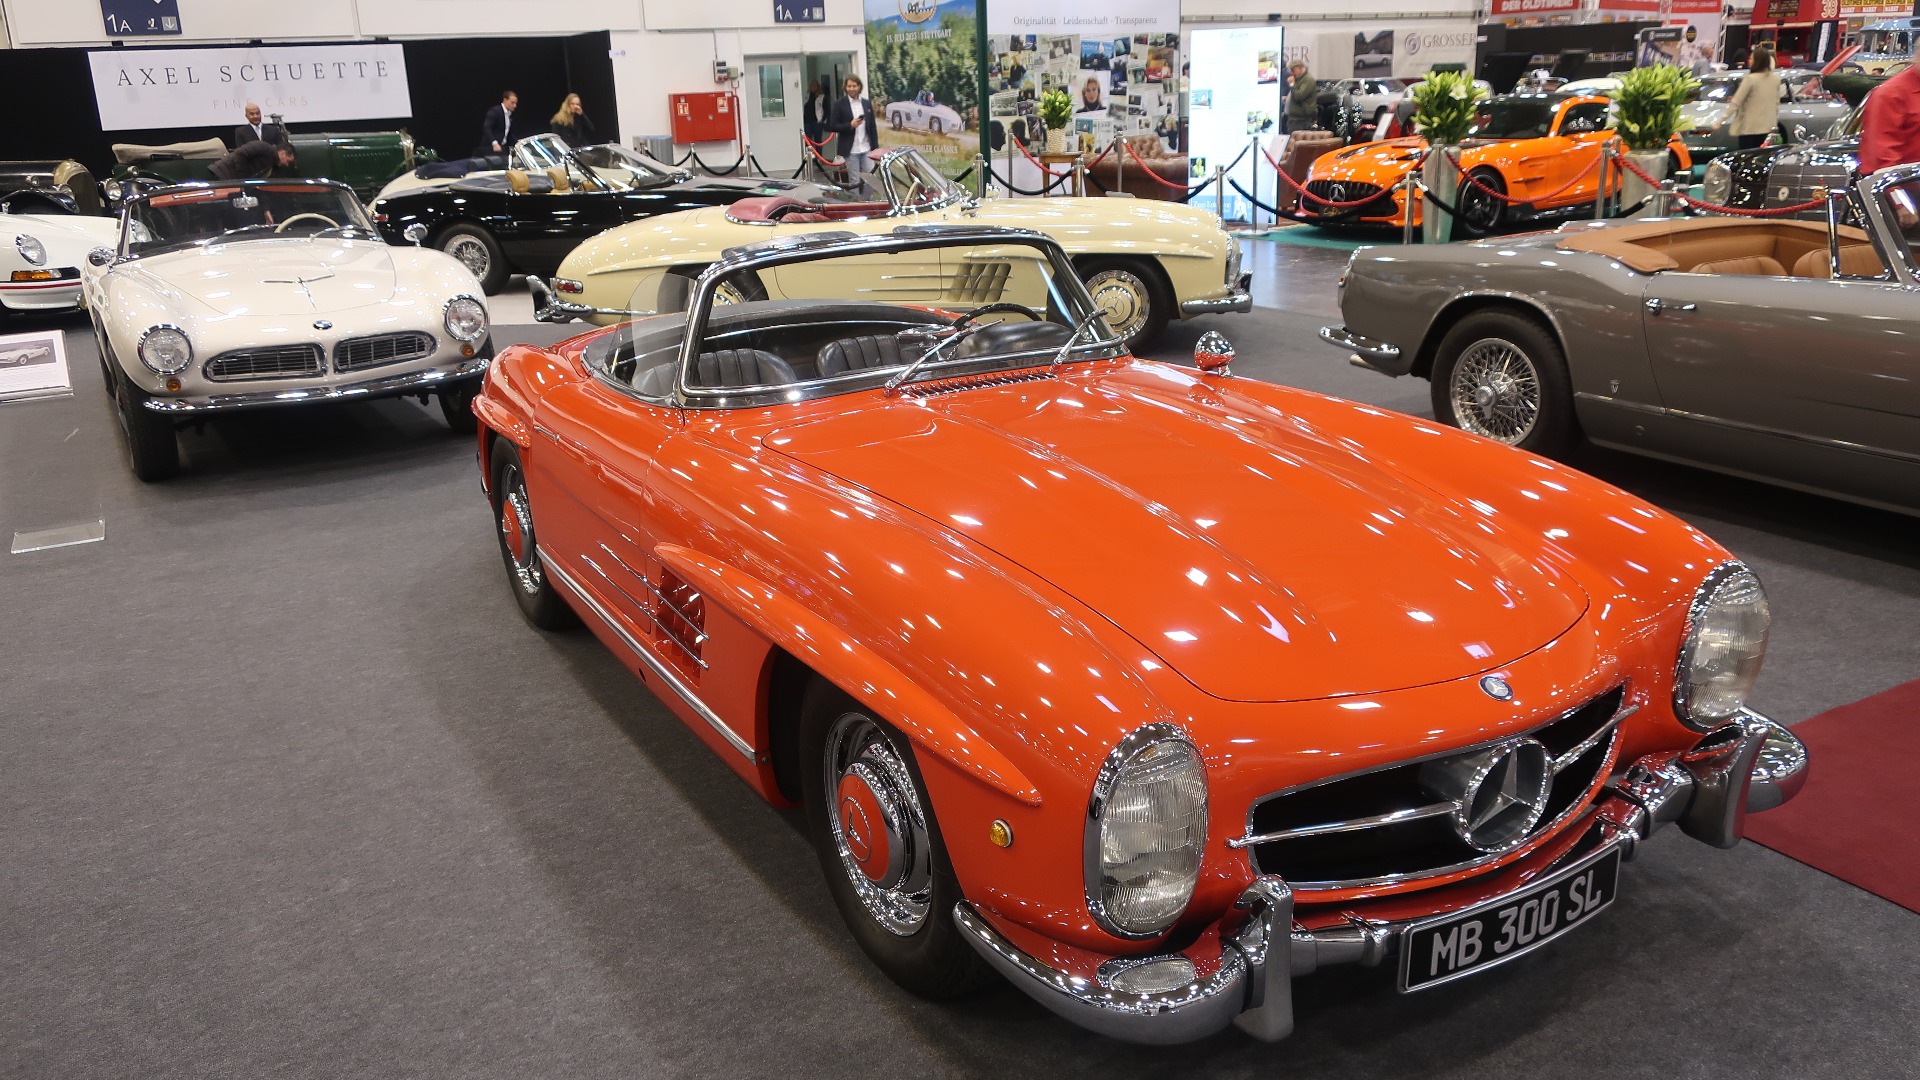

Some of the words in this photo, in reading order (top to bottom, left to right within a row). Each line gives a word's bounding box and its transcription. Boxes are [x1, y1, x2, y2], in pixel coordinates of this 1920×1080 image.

[776, 4, 793, 20] 1A
[107, 13, 132, 33] 1A
[1013, 15, 1056, 26] Originalität
[1063, 15, 1108, 25] Leidenschaft
[1115, 15, 1158, 26] Transparenz
[1423, 32, 1478, 48] GROSSER
[117, 66, 201, 87] AXEL
[219, 60, 389, 83] SCHUETTE
[265, 95, 309, 108] CARS
[1430, 920, 1483, 977] MB
[1494, 889, 1560, 954] 300
[1566, 869, 1602, 922] SL
